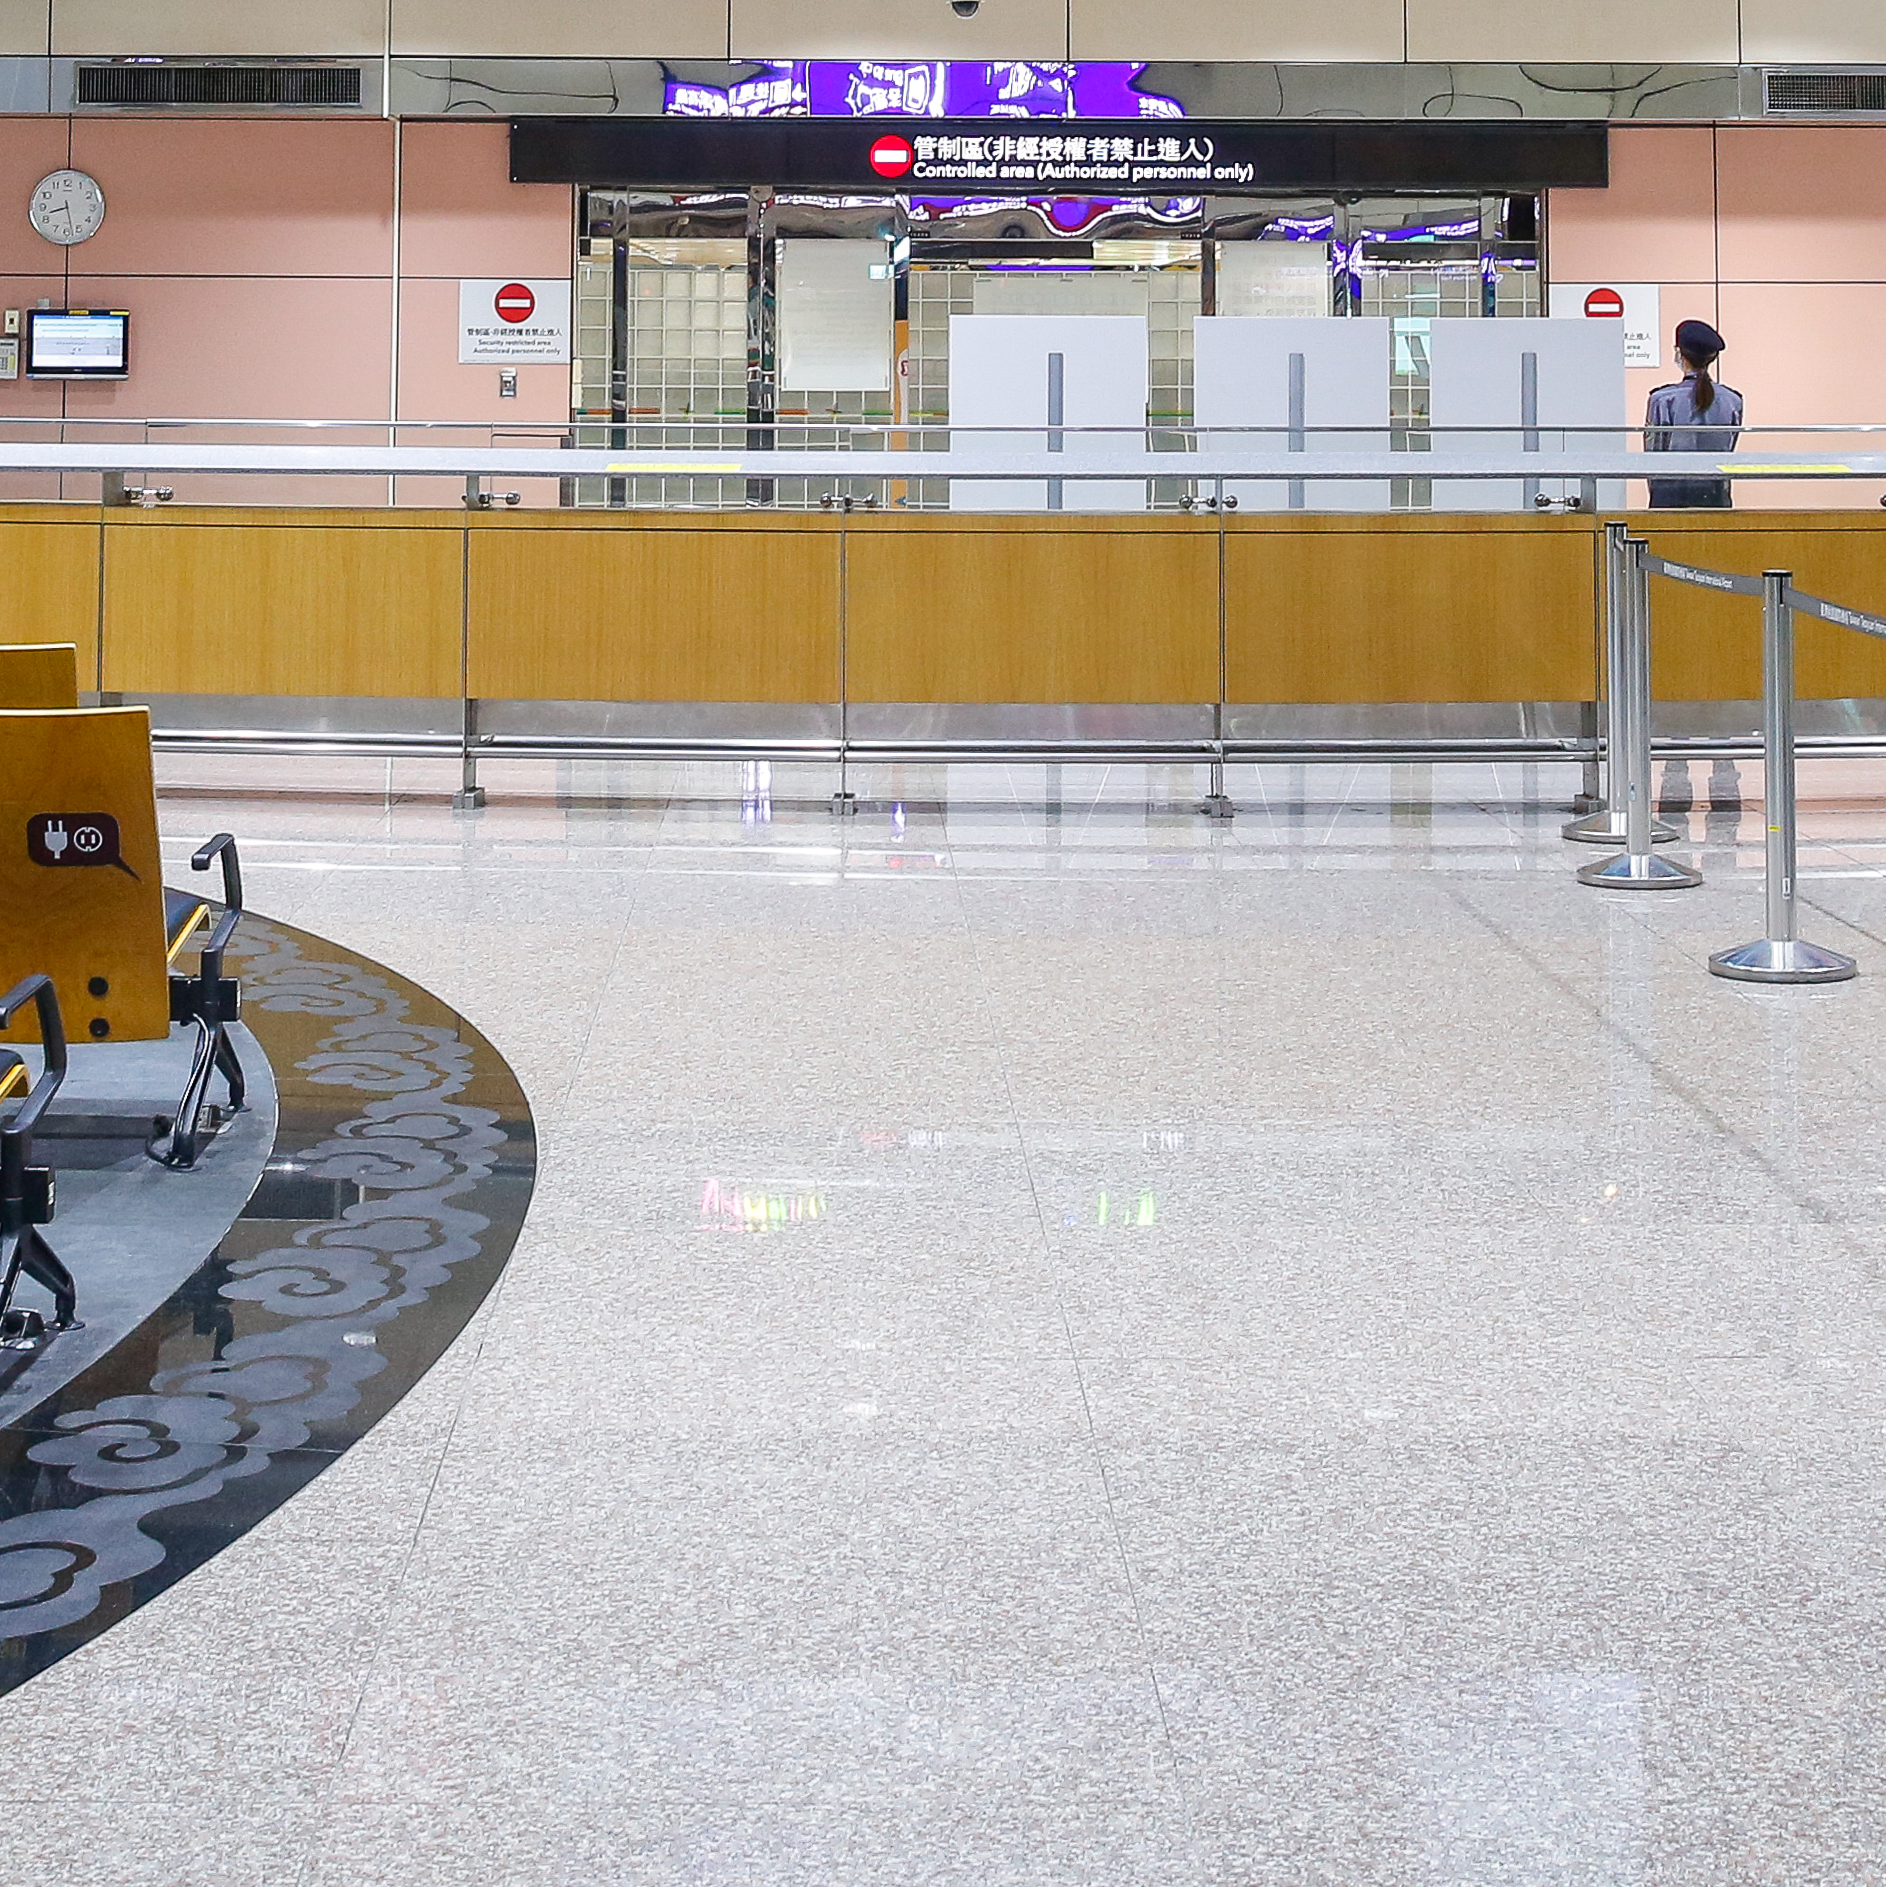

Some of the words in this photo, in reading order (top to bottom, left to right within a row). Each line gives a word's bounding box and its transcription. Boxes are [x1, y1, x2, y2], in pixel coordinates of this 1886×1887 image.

[913, 161, 998, 179] Controlled
[1000, 165, 1034, 179] area
[1037, 162, 1129, 181] (Authorized
[1132, 161, 1211, 183] personnel
[1214, 161, 1254, 182] only)
